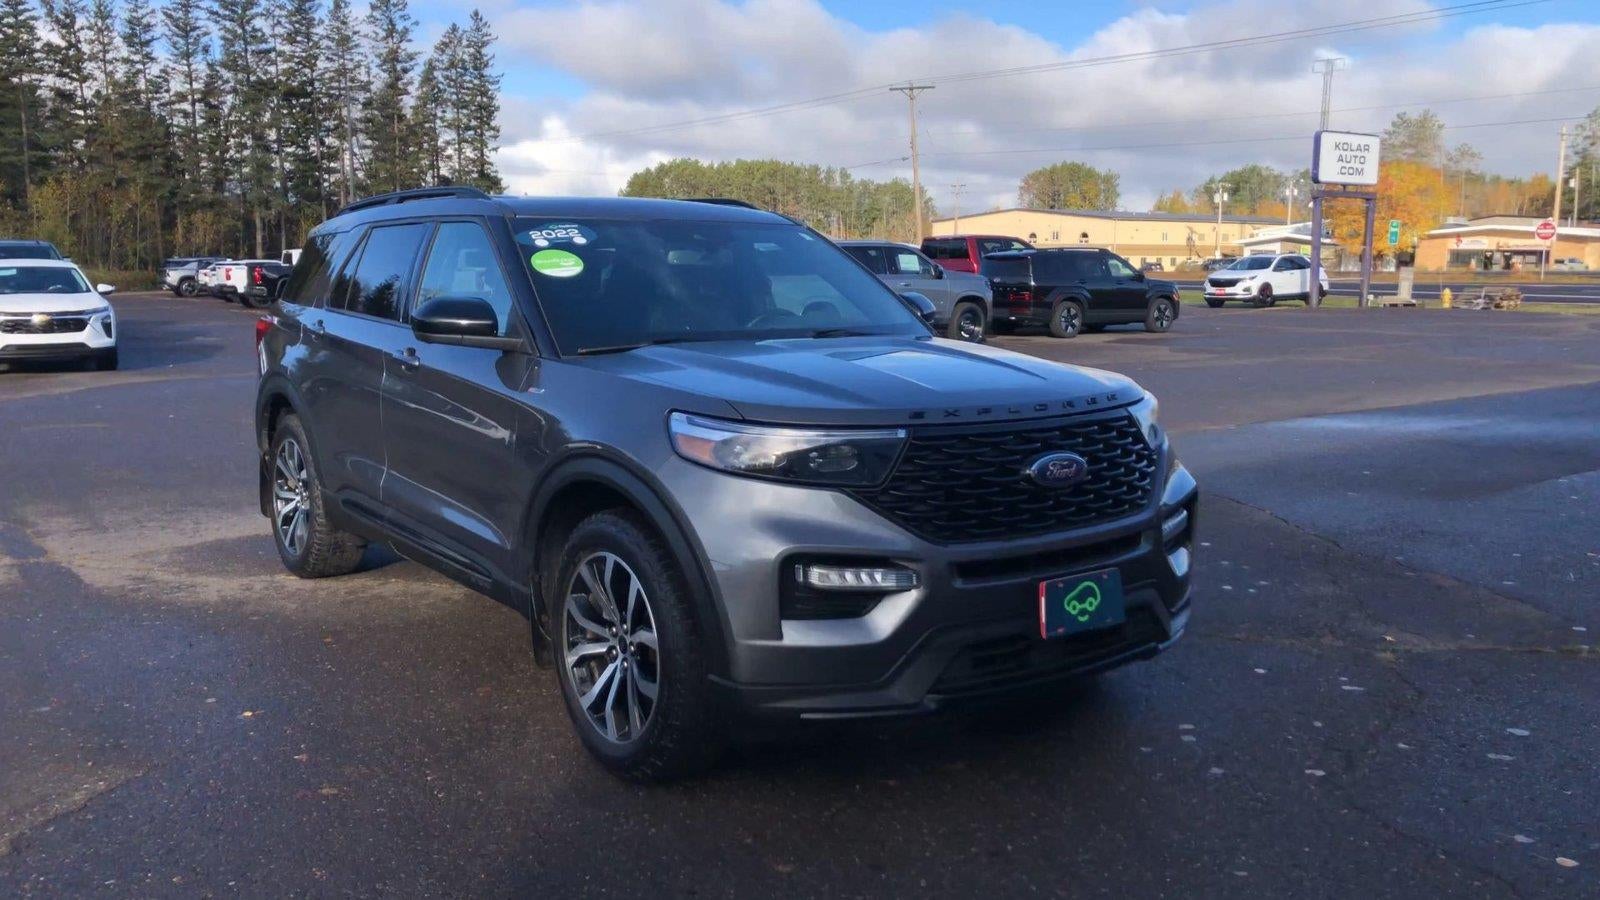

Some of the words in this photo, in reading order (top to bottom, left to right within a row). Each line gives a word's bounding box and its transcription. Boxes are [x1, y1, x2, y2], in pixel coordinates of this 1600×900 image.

[1334, 141, 1370, 153] KOLAR
[1337, 154, 1366, 165] AUTO
[1337, 166, 1364, 176] .COM
[529, 228, 582, 240] 2022
[908, 392, 1118, 420] EXPLORER
[1047, 460, 1077, 480] Ford
